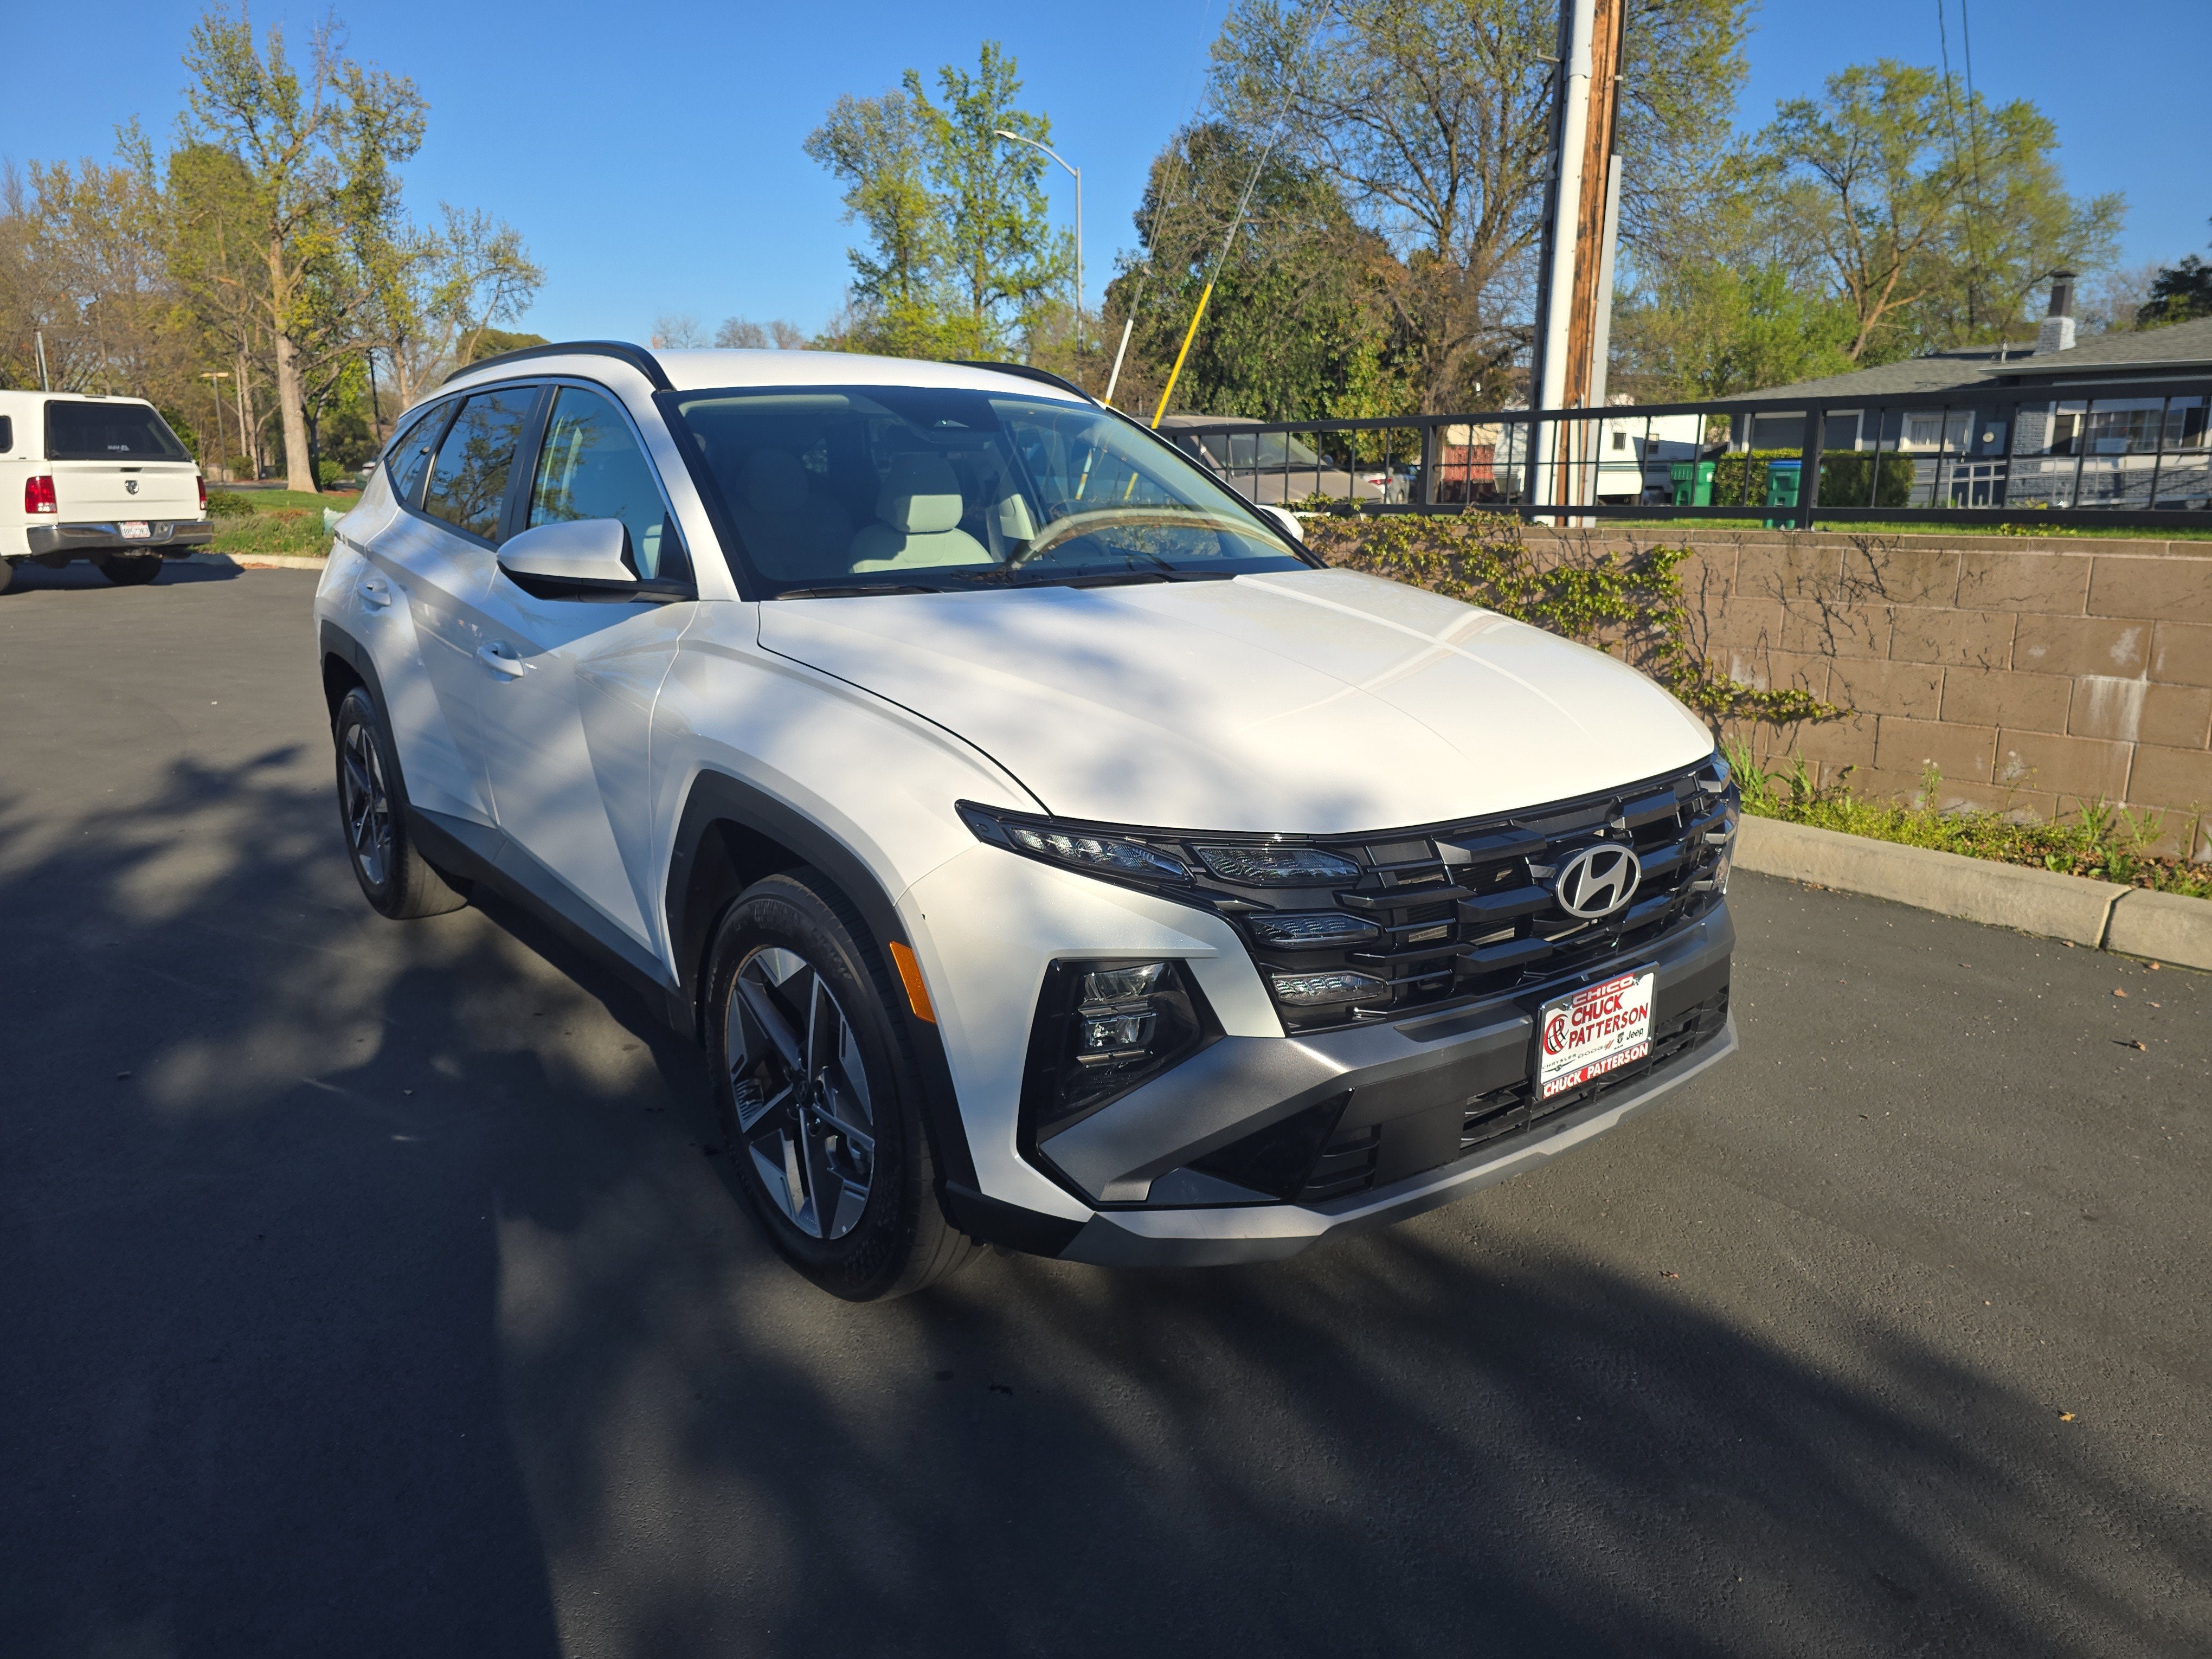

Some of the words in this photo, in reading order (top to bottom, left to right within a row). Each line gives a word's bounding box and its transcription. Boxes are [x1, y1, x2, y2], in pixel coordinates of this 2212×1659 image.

[1572, 975, 1634, 1005] CHICO
[1571, 992, 1625, 1027] CHUCK
[1568, 1002, 1649, 1050] PATTERSON
[1626, 1027, 1644, 1040] Jeep
[1542, 1053, 1577, 1070] CHRYSLER
[1544, 1070, 1582, 1098] CHUCK
[1587, 1042, 1649, 1079] PATTERSON
